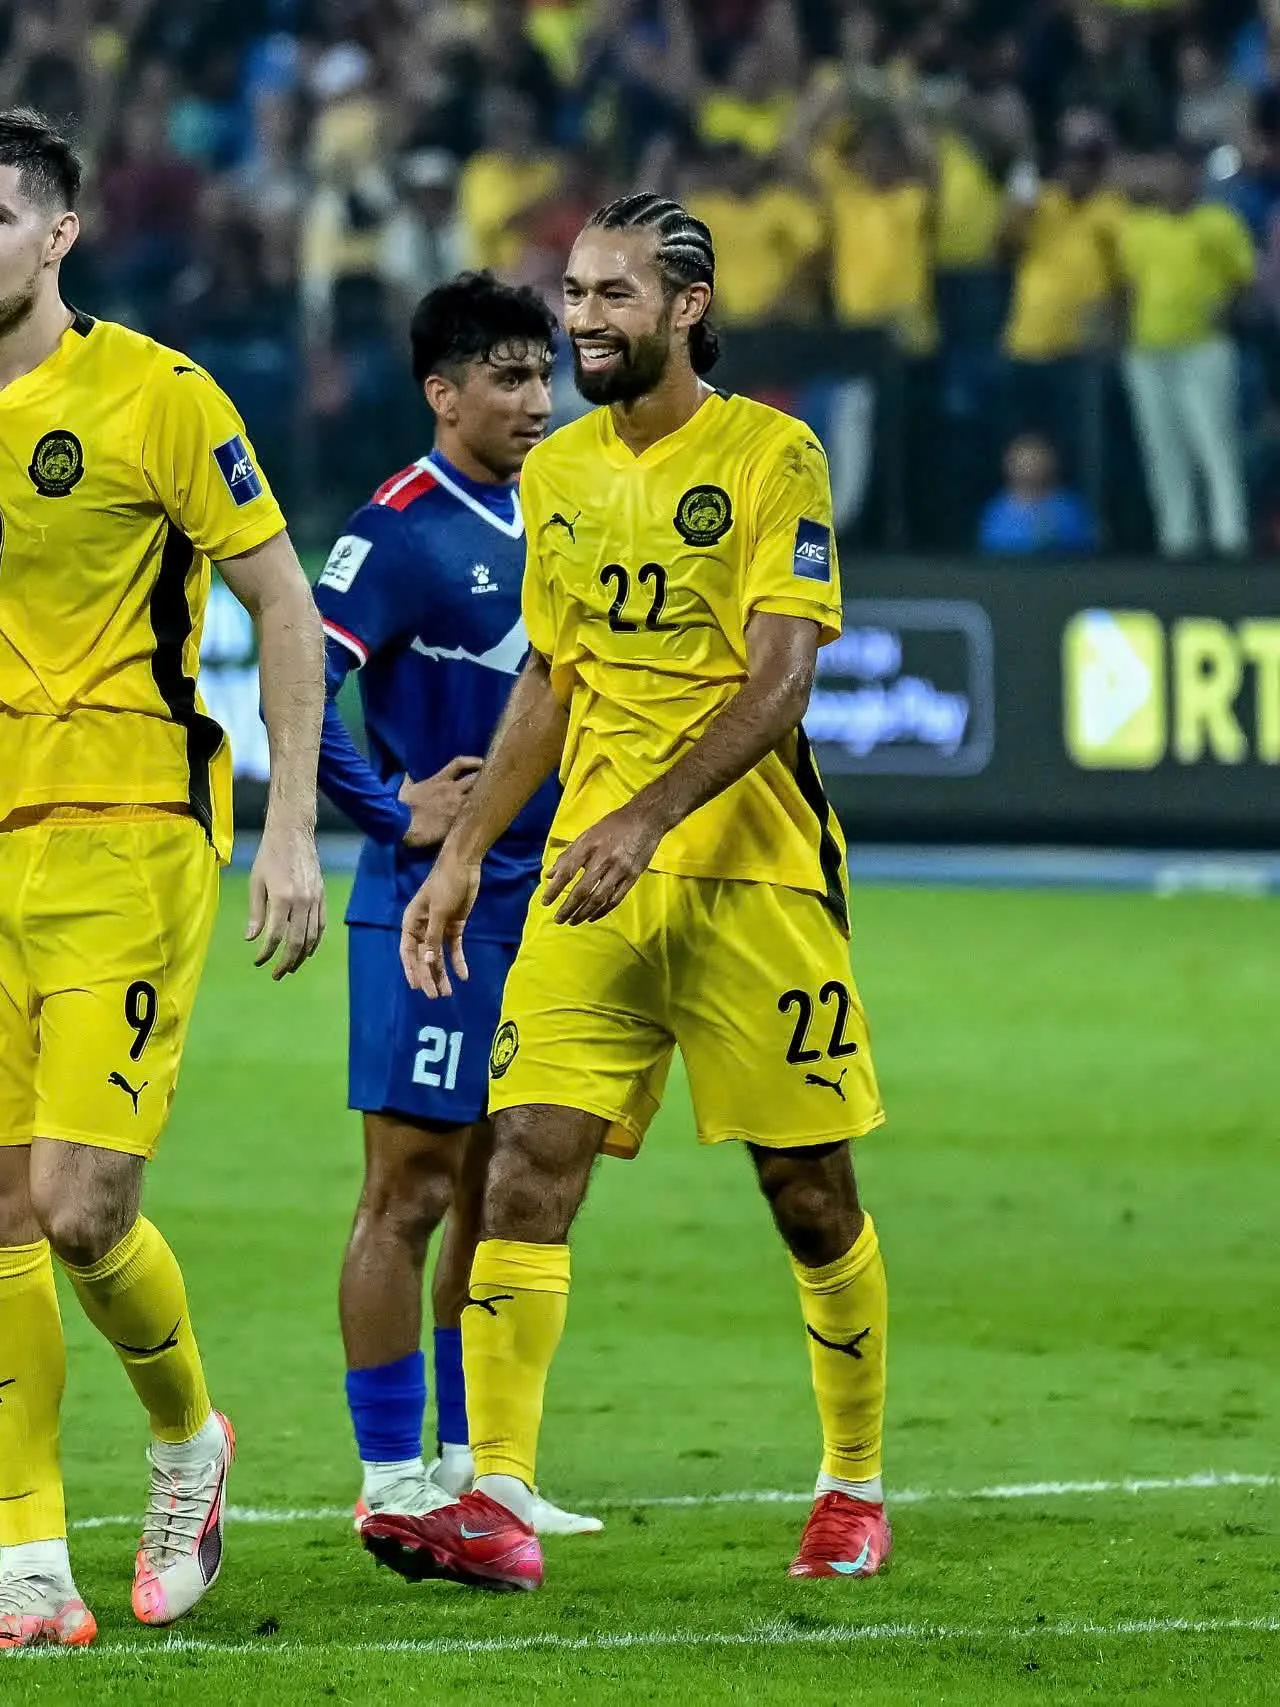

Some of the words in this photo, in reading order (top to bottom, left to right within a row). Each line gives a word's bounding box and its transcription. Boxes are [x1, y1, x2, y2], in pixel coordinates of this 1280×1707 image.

[796, 541, 826, 561] AFC
[599, 562, 681, 633] 22
[124, 980, 158, 1061] 9
[777, 980, 858, 1065] 22
[412, 1025, 464, 1091] 21
